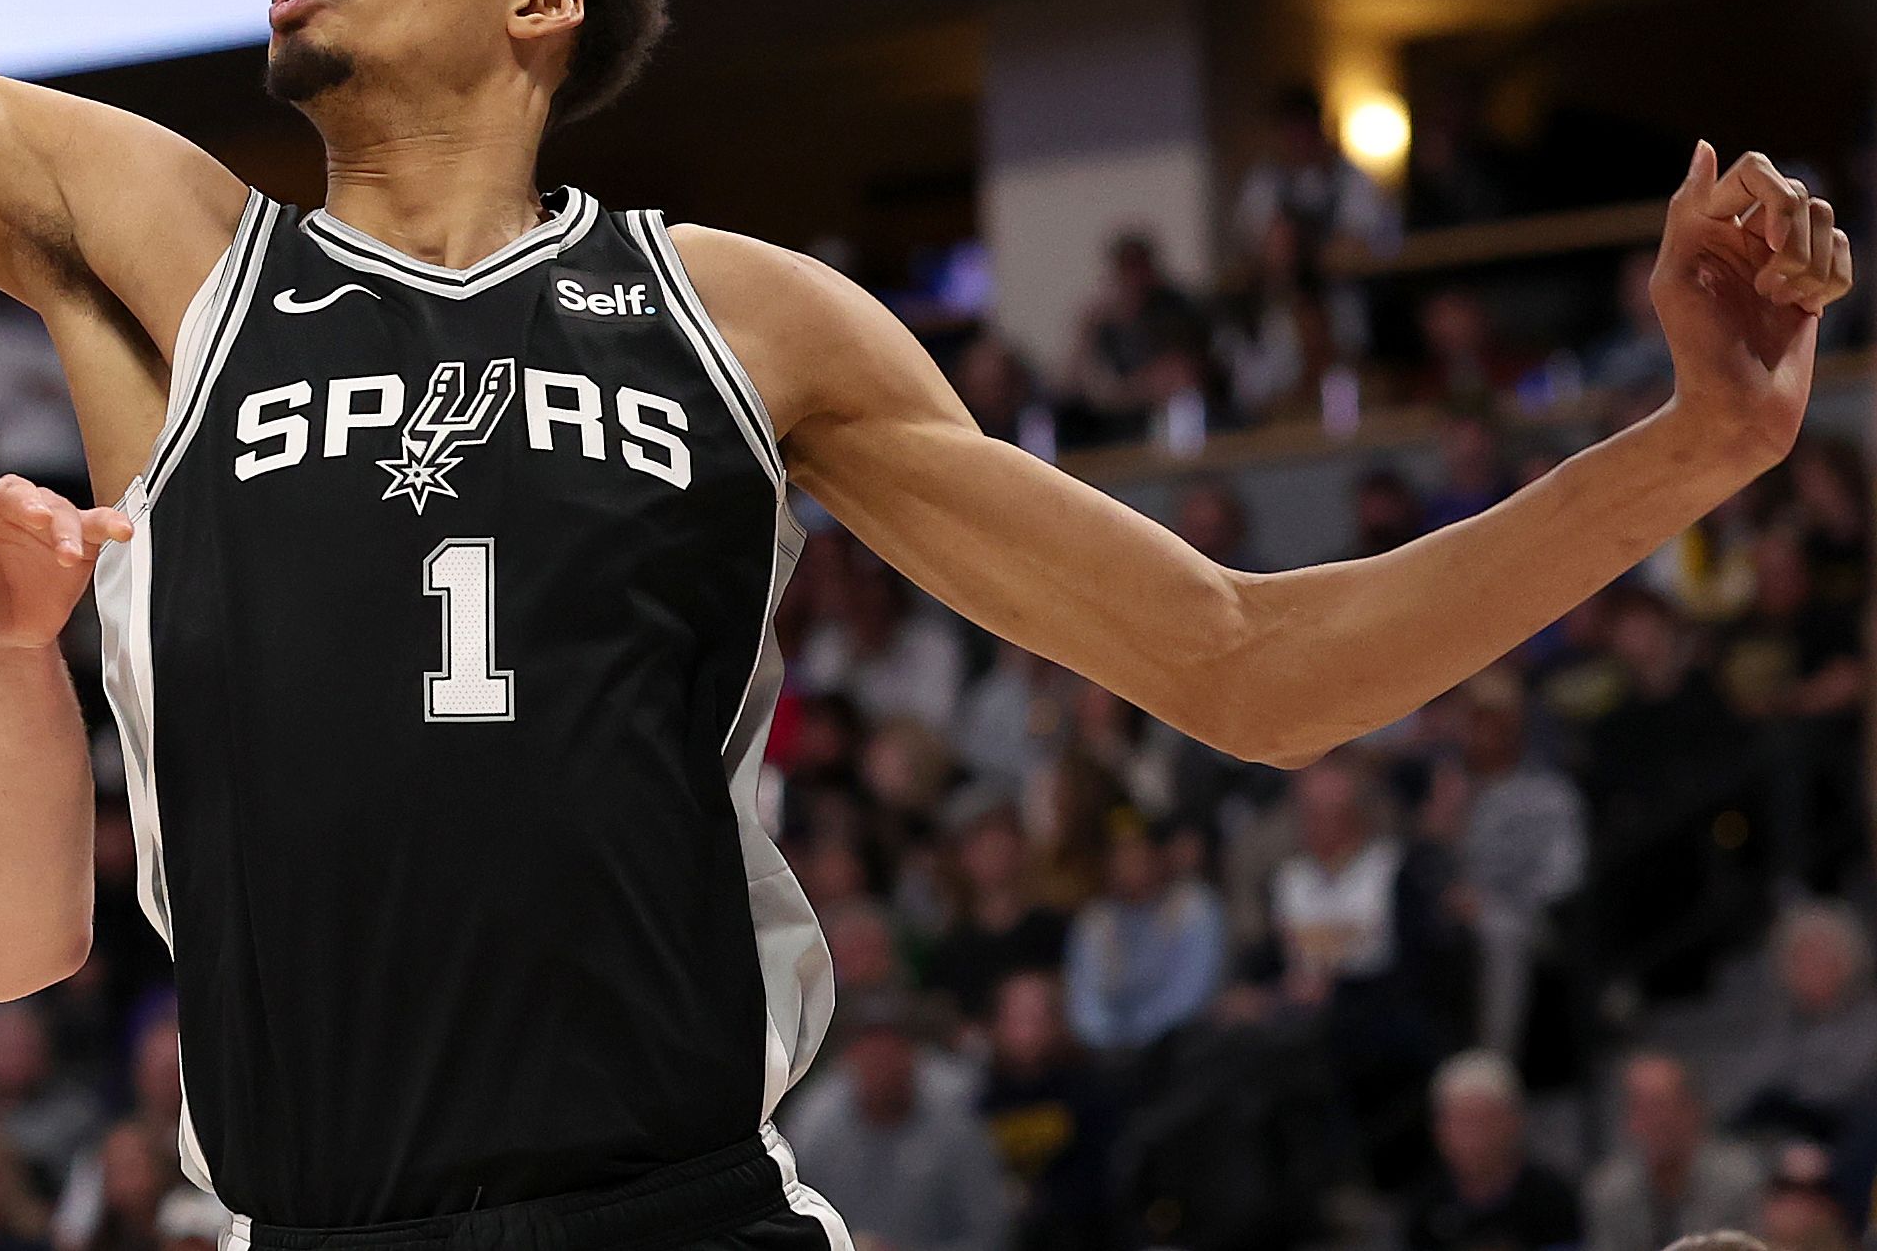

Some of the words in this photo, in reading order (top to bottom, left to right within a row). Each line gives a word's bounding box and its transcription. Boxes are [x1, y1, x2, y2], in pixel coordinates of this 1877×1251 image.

[556, 279, 656, 316] Self.
[235, 357, 692, 515] SPURS
[423, 537, 515, 722] 1
